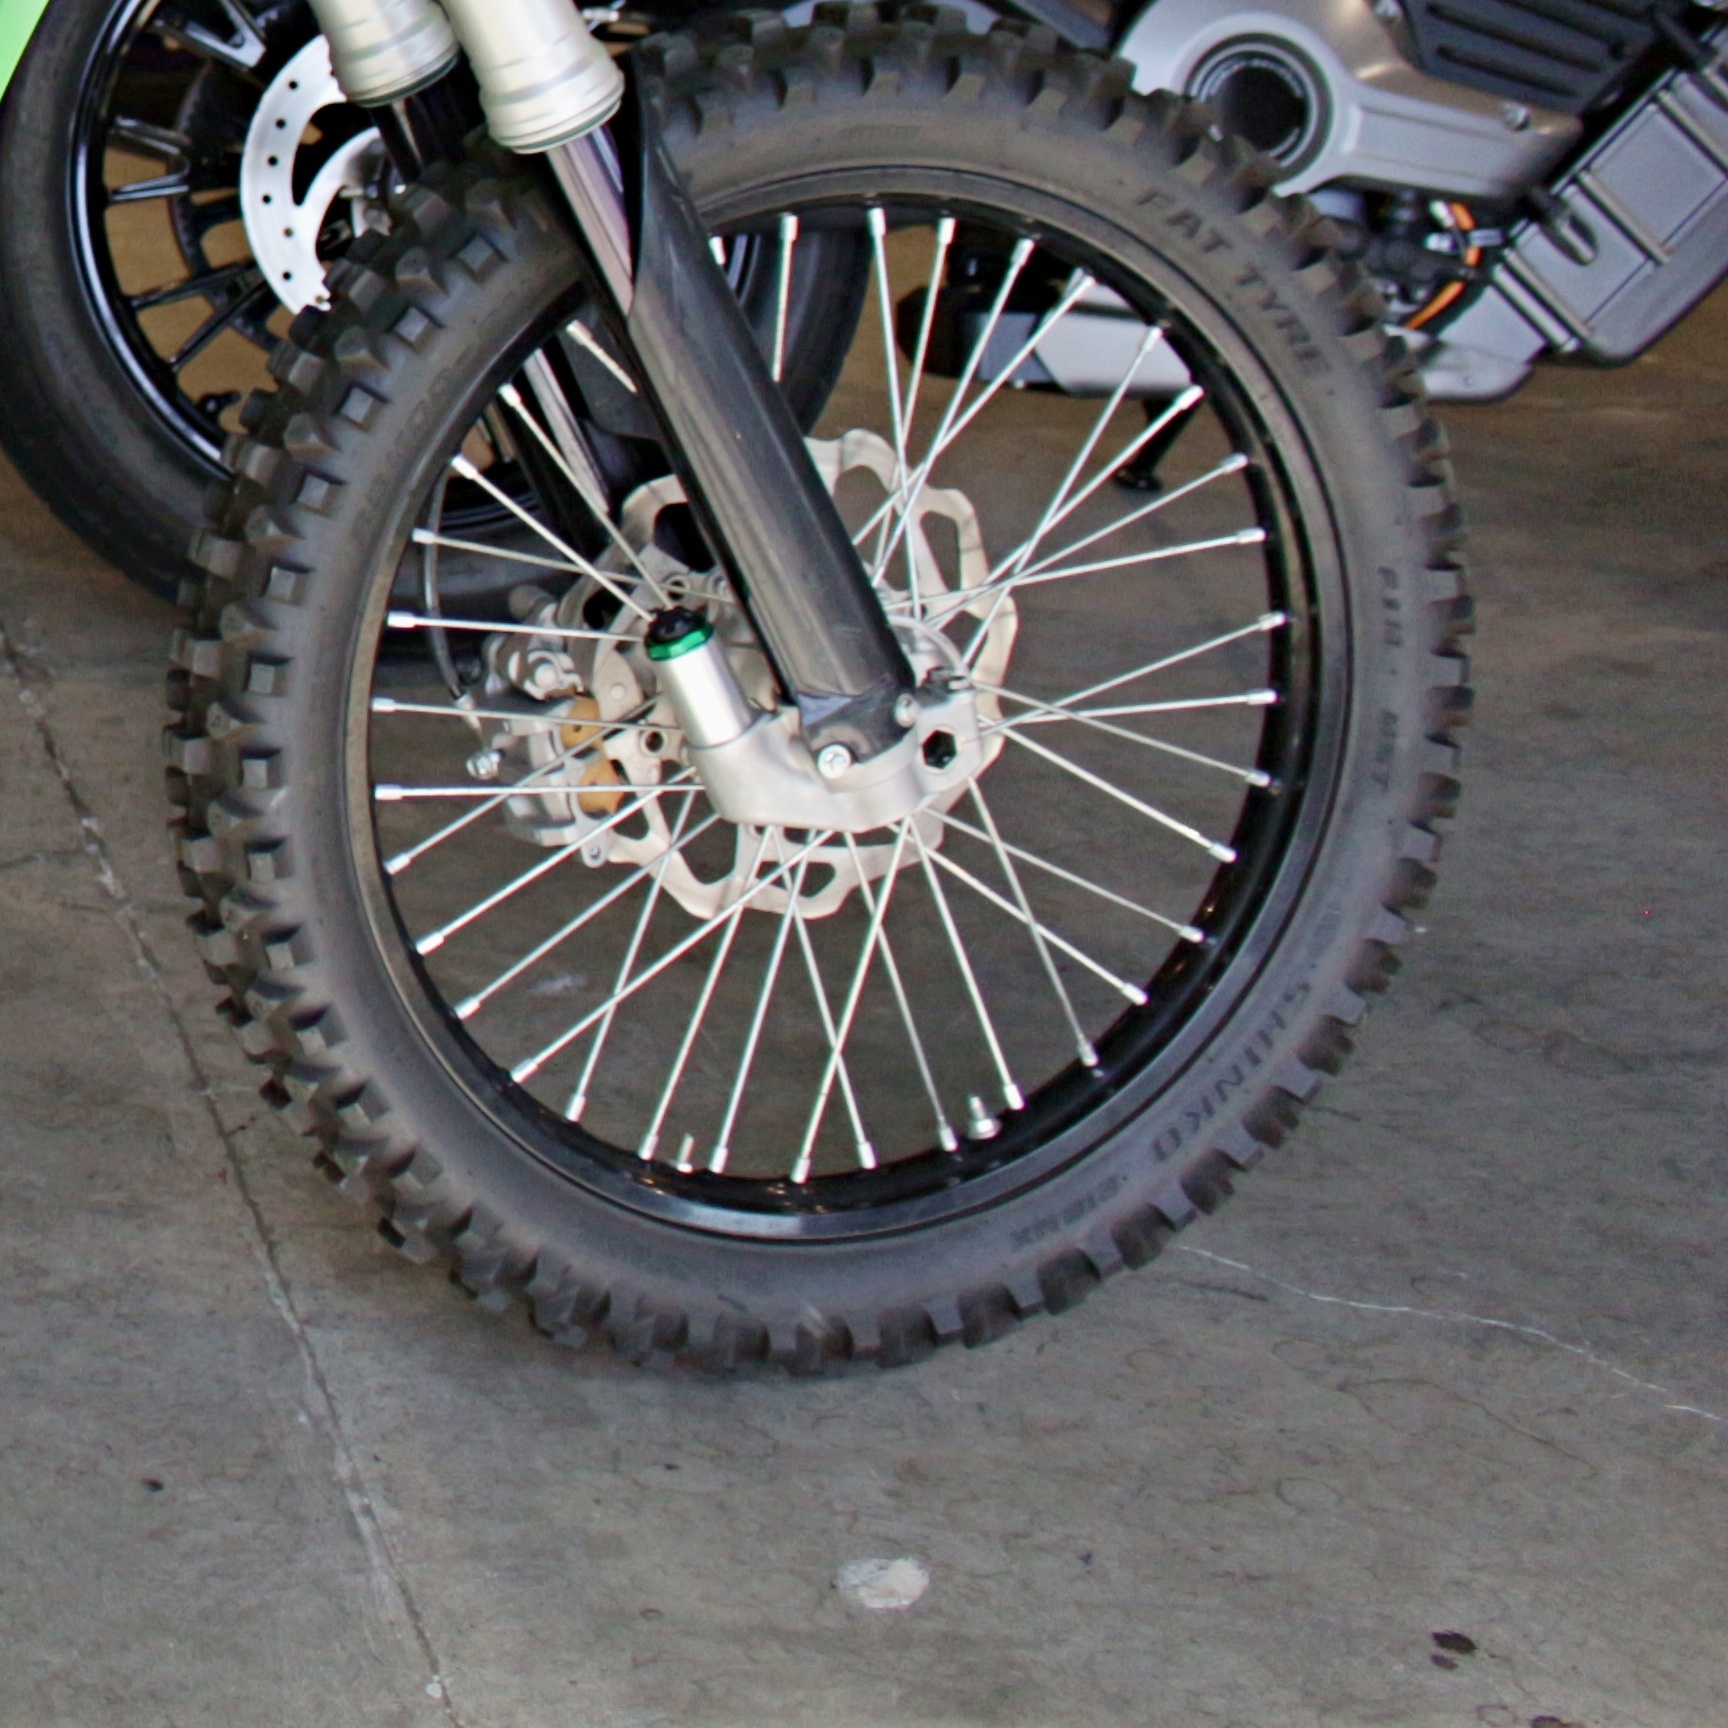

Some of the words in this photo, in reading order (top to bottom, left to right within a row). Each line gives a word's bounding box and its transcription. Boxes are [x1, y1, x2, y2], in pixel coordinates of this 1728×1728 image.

[1131, 179, 1236, 263] FAT
[1230, 259, 1334, 384] TYRE
[1147, 976, 1312, 1164] SHINKO
